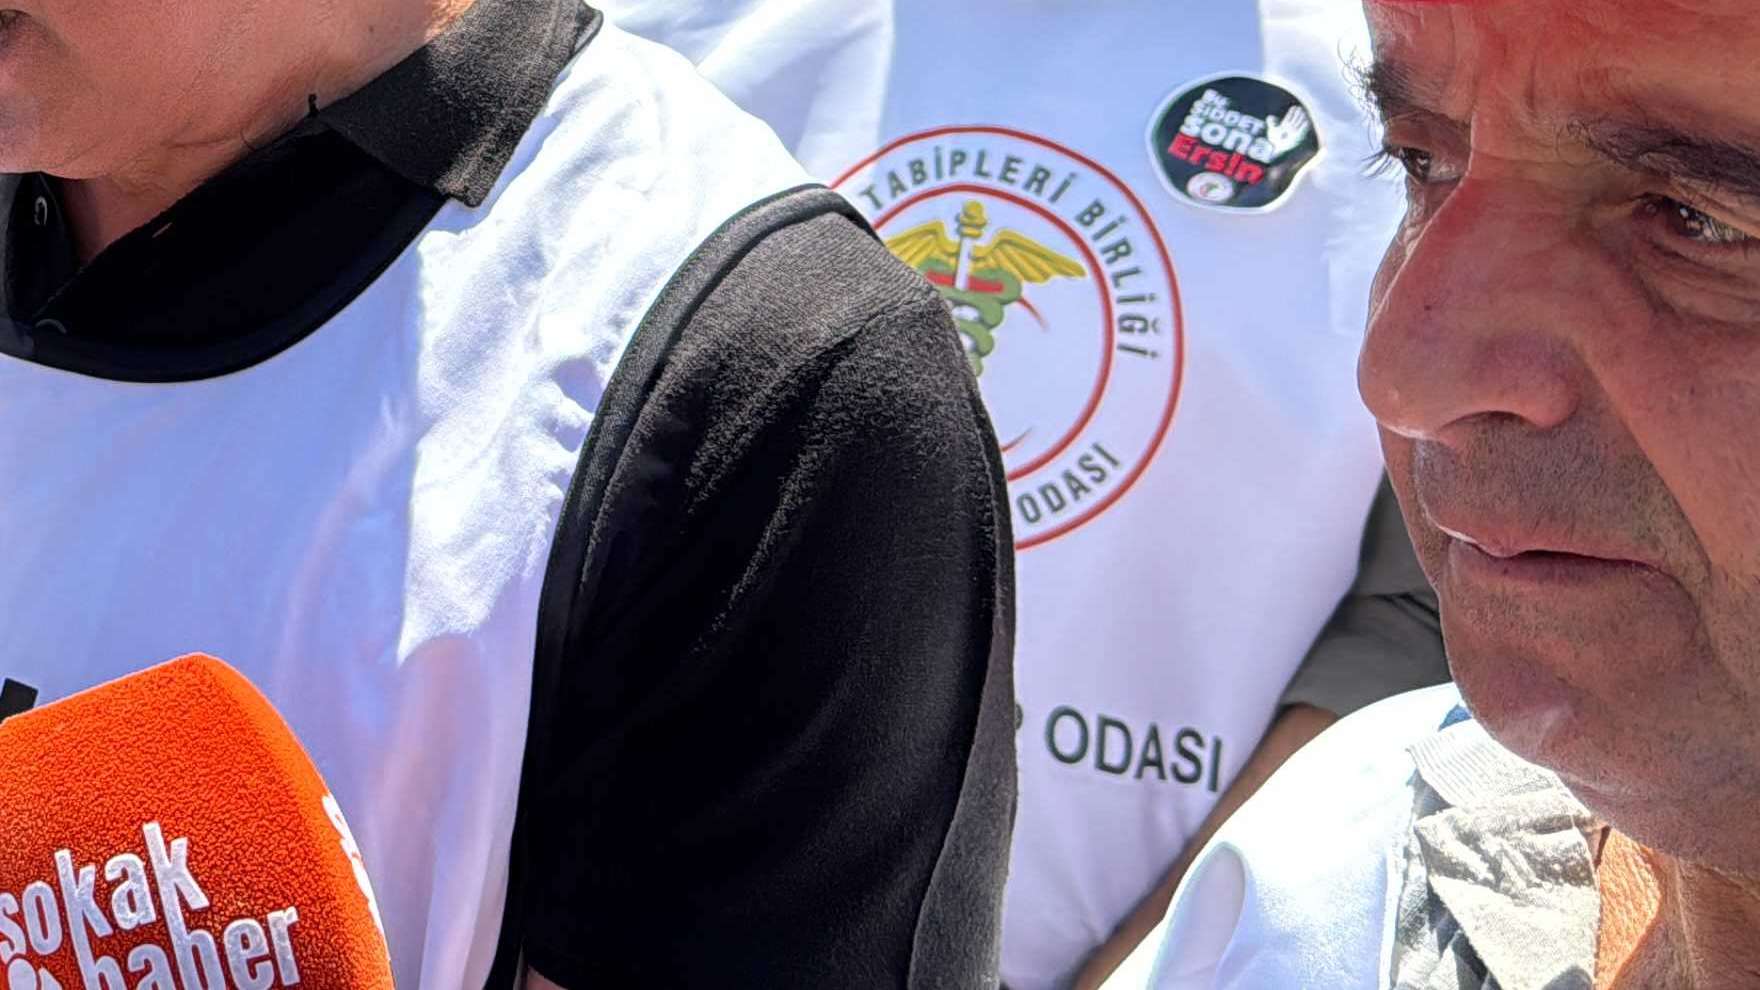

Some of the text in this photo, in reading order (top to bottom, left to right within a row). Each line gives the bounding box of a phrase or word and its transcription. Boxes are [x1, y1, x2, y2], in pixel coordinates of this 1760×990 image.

[859, 145, 1162, 360] TABİPLERİ BİRLİĞİ
[1015, 442, 1121, 525] ODASI
[1044, 704, 1223, 793] ODASI
